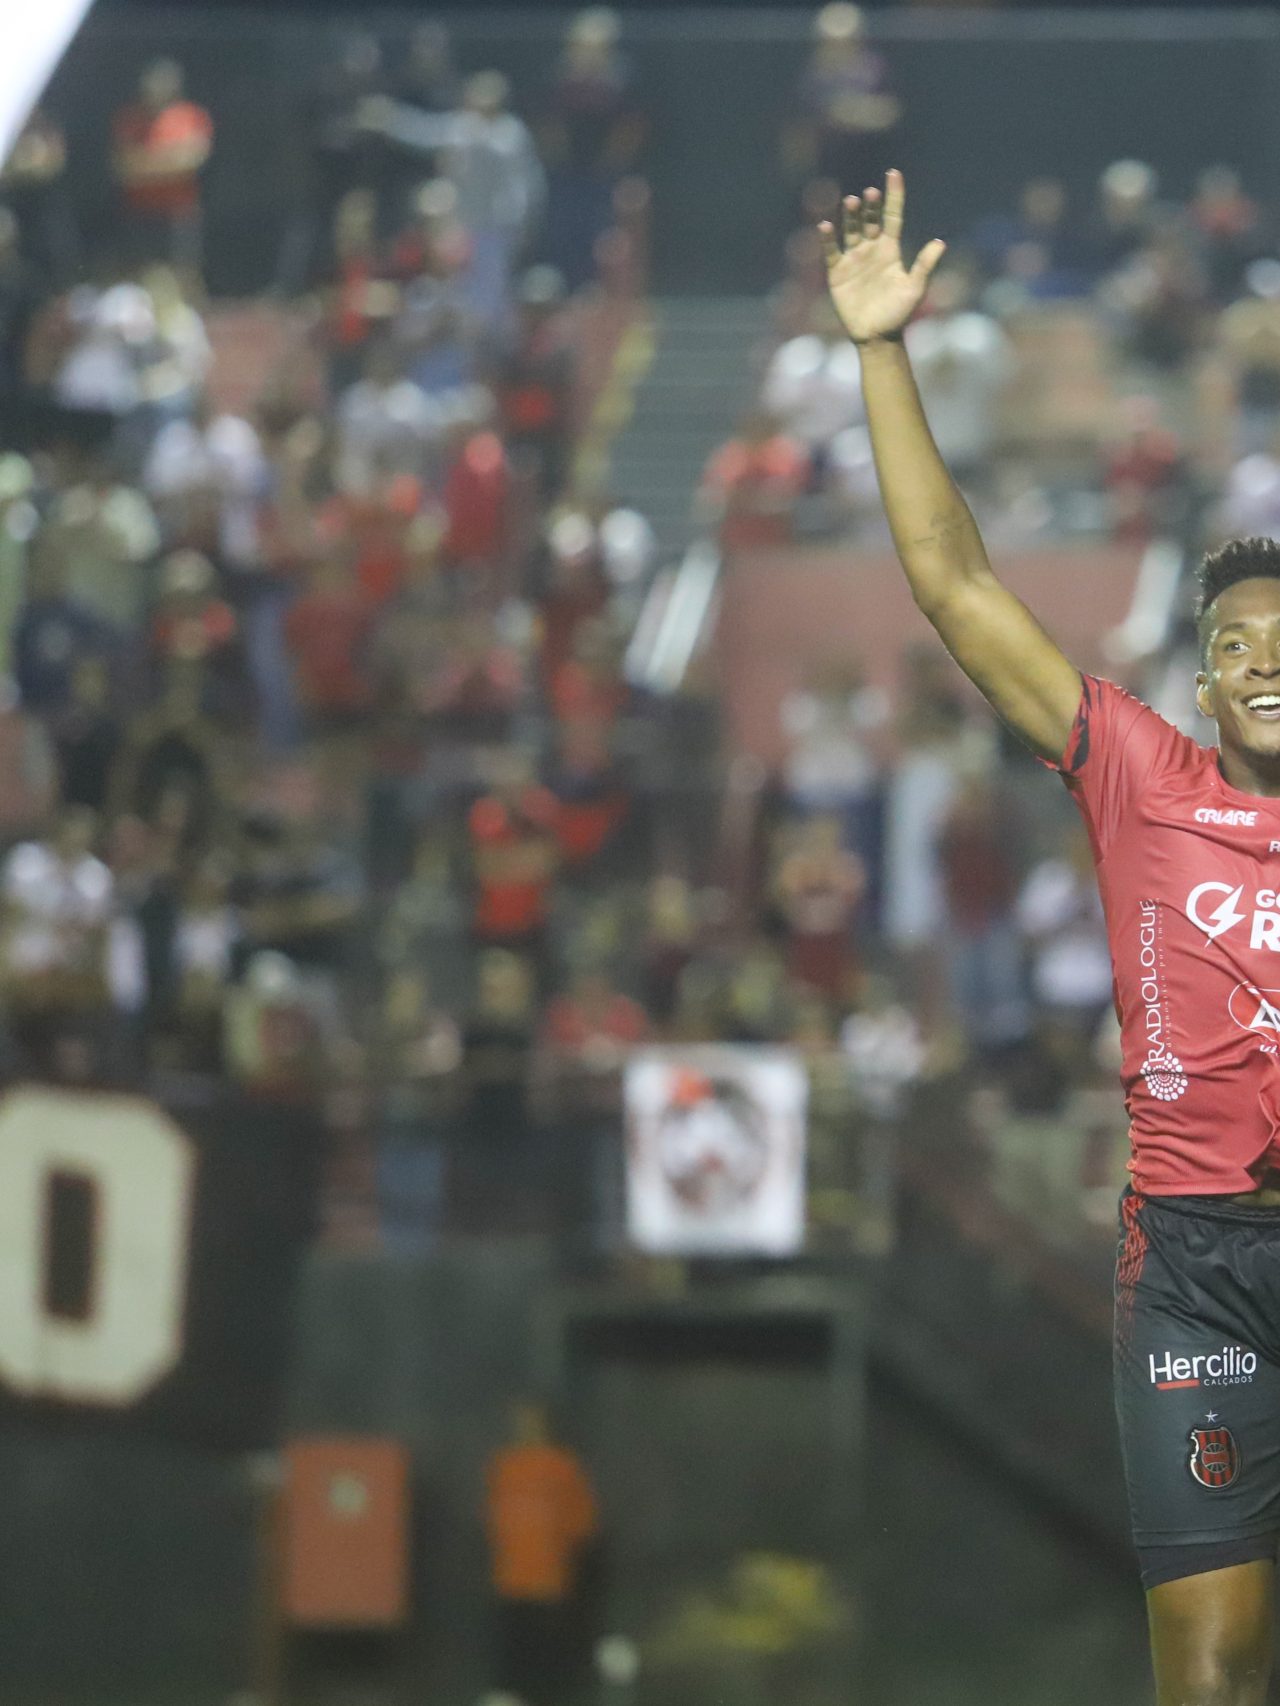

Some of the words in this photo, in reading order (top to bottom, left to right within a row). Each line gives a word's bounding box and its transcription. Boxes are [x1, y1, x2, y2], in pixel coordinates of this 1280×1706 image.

[1194, 808, 1259, 827] CRIARE
[1139, 898, 1166, 1063] RADIOLOGUE
[1203, 1375, 1253, 1386] CALÇADOS
